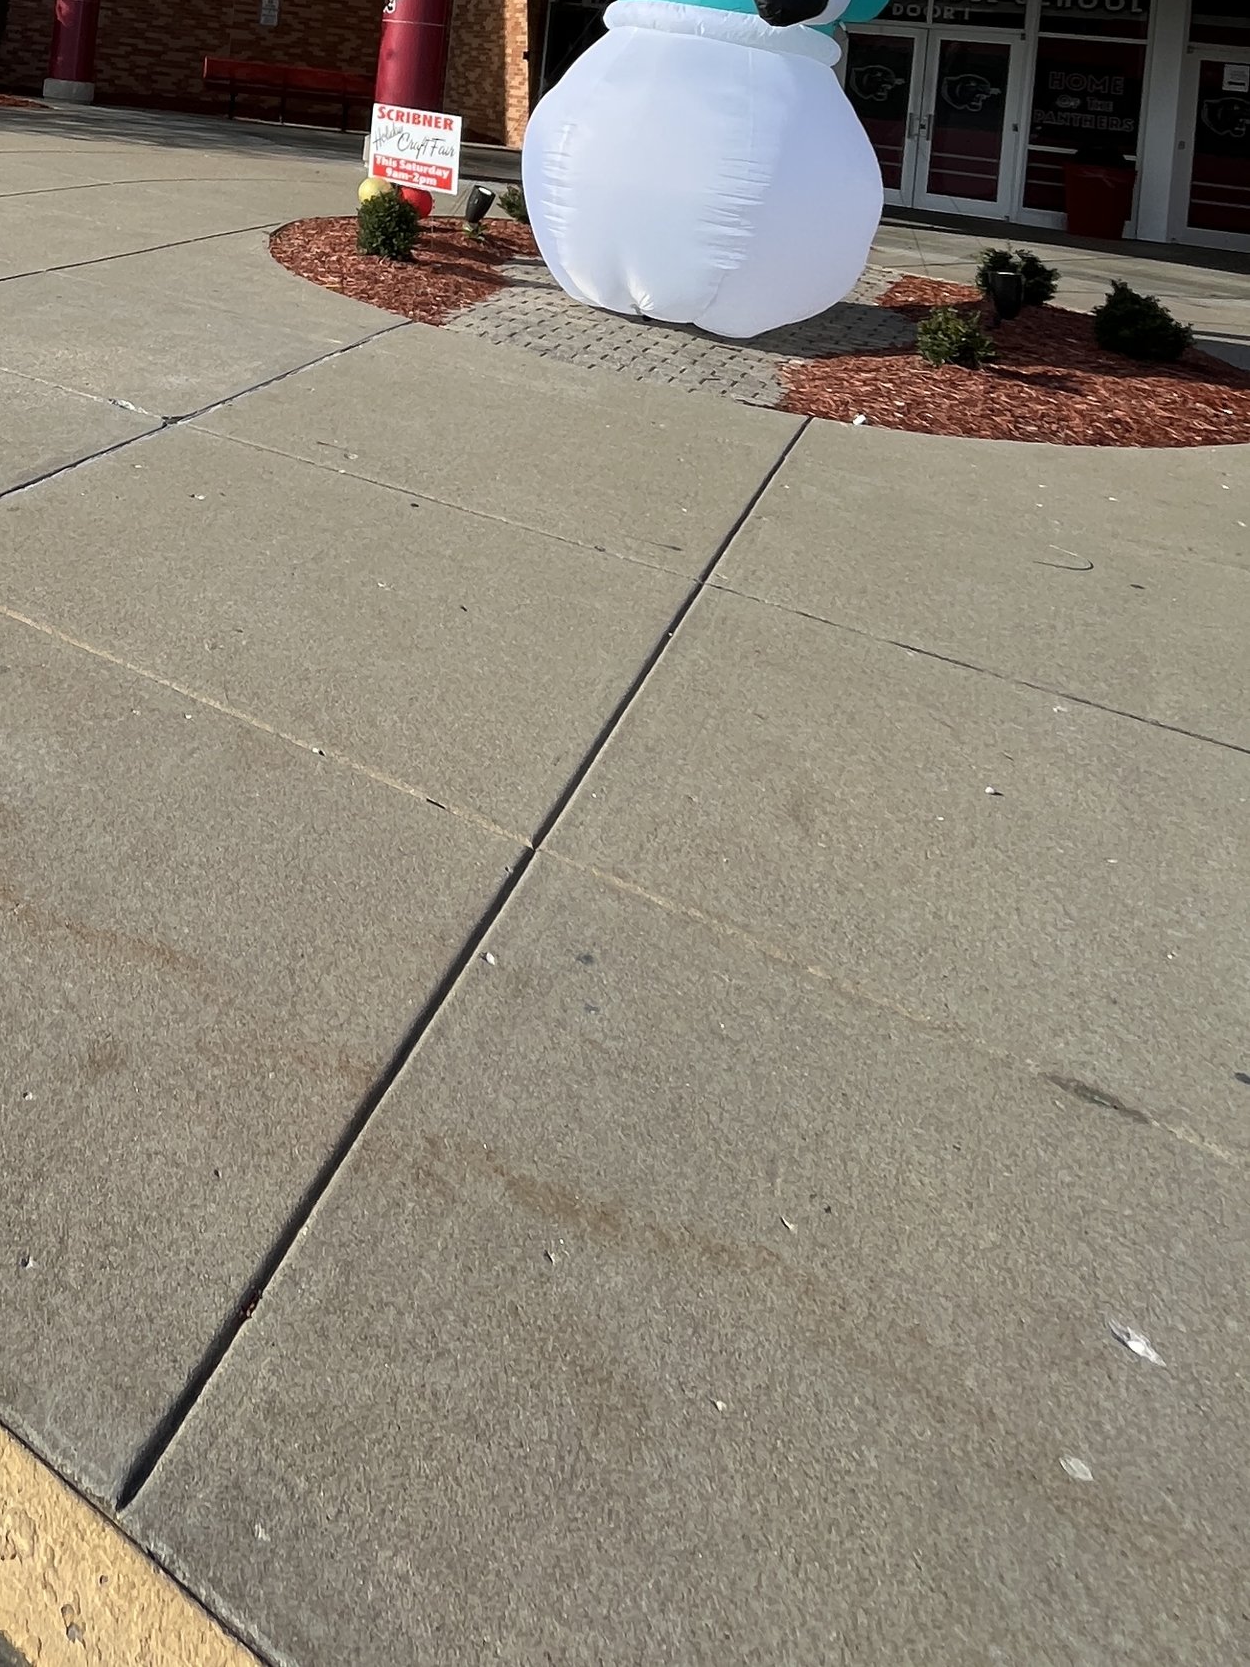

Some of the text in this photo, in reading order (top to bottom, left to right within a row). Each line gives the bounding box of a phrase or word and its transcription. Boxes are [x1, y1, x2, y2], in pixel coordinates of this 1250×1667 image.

[892, 2, 955, 20] DOOR
[1047, 71, 1125, 95] HOME
[377, 106, 454, 131] SCRIBNER
[1033, 109, 1135, 133] PANTHERS
[397, 132, 455, 160] Craft Fair
[375, 155, 450, 179] This Saturday
